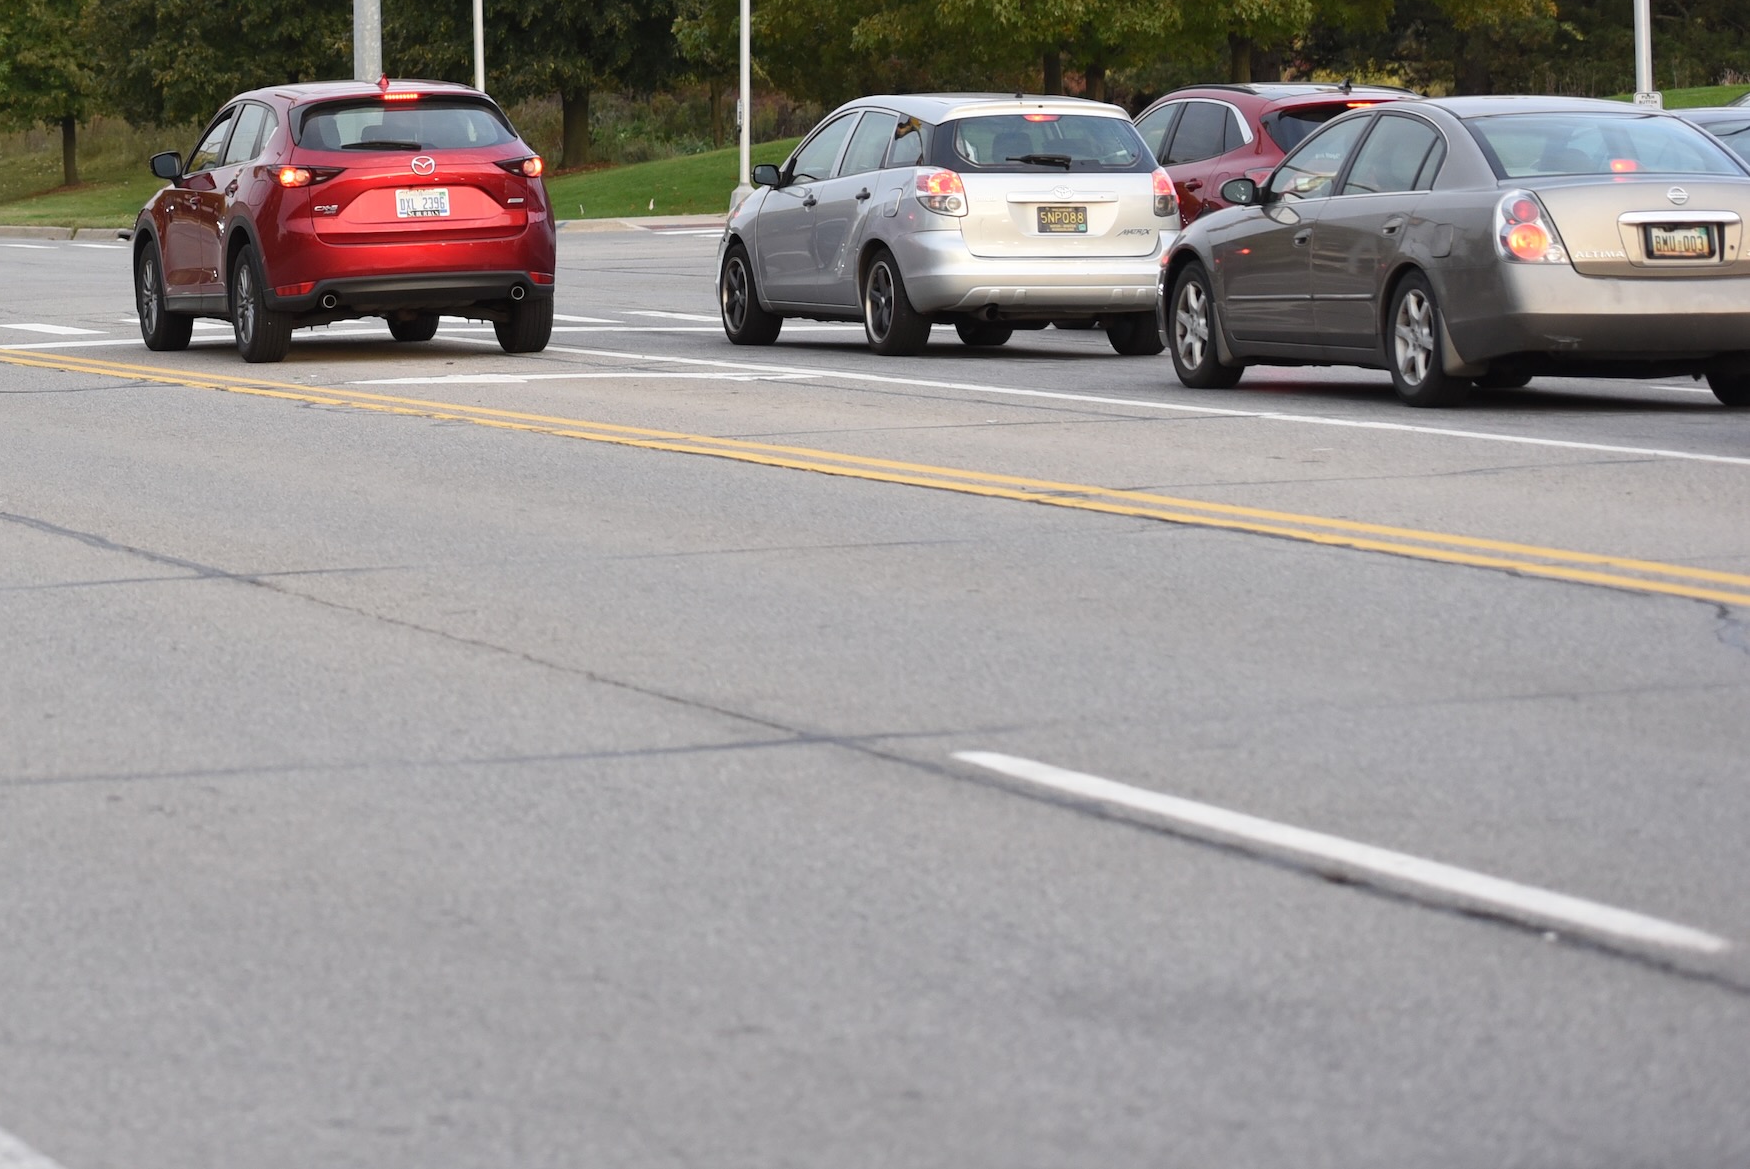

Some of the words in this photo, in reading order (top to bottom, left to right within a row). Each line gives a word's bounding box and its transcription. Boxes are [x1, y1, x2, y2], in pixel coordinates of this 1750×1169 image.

[400, 198, 417, 210] DXL
[422, 196, 445, 210] 2396
[1575, 250, 1626, 259] ALTIMA
